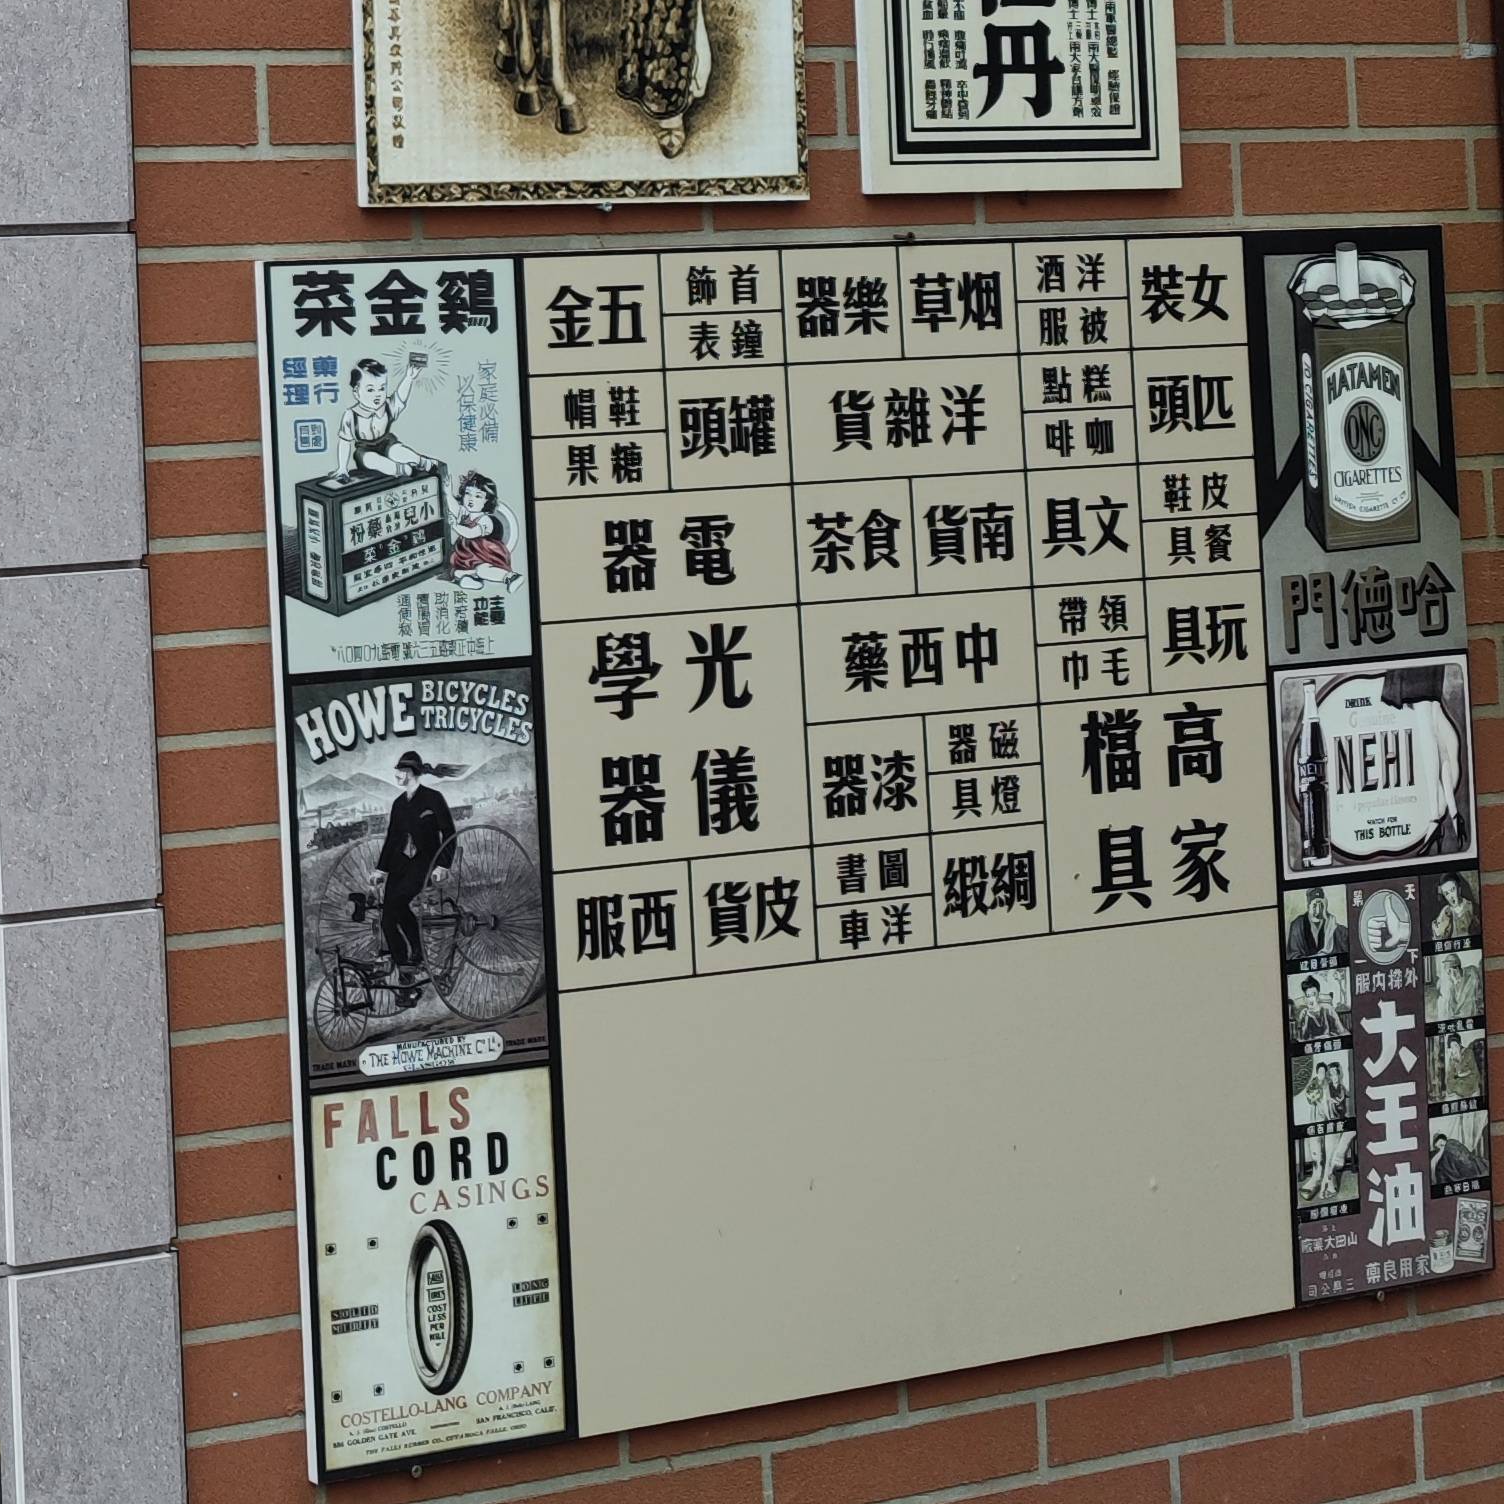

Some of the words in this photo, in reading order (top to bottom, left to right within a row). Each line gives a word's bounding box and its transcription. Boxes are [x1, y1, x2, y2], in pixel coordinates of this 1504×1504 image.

[1326, 361, 1402, 405] HATAMEN
[1333, 466, 1403, 488] CIGARETTES
[421, 679, 530, 717] BICYCLES
[1344, 696, 1372, 709] DRINK
[295, 682, 417, 765] HOWE
[420, 705, 533, 745] TRICYCLES
[1332, 728, 1416, 796] NEHI
[1354, 828, 1375, 842] THIS
[1379, 823, 1412, 839] BOTTLE
[368, 1052, 390, 1069] THE
[392, 1048, 424, 1066] HOWE
[426, 1041, 474, 1064] MACHINE
[323, 1086, 471, 1149] FALLS
[376, 1131, 510, 1191] CORD
[409, 1174, 551, 1215] CASINGS
[340, 1395, 468, 1429] COSTELLO-LANG
[476, 1380, 553, 1406] COMPANY
